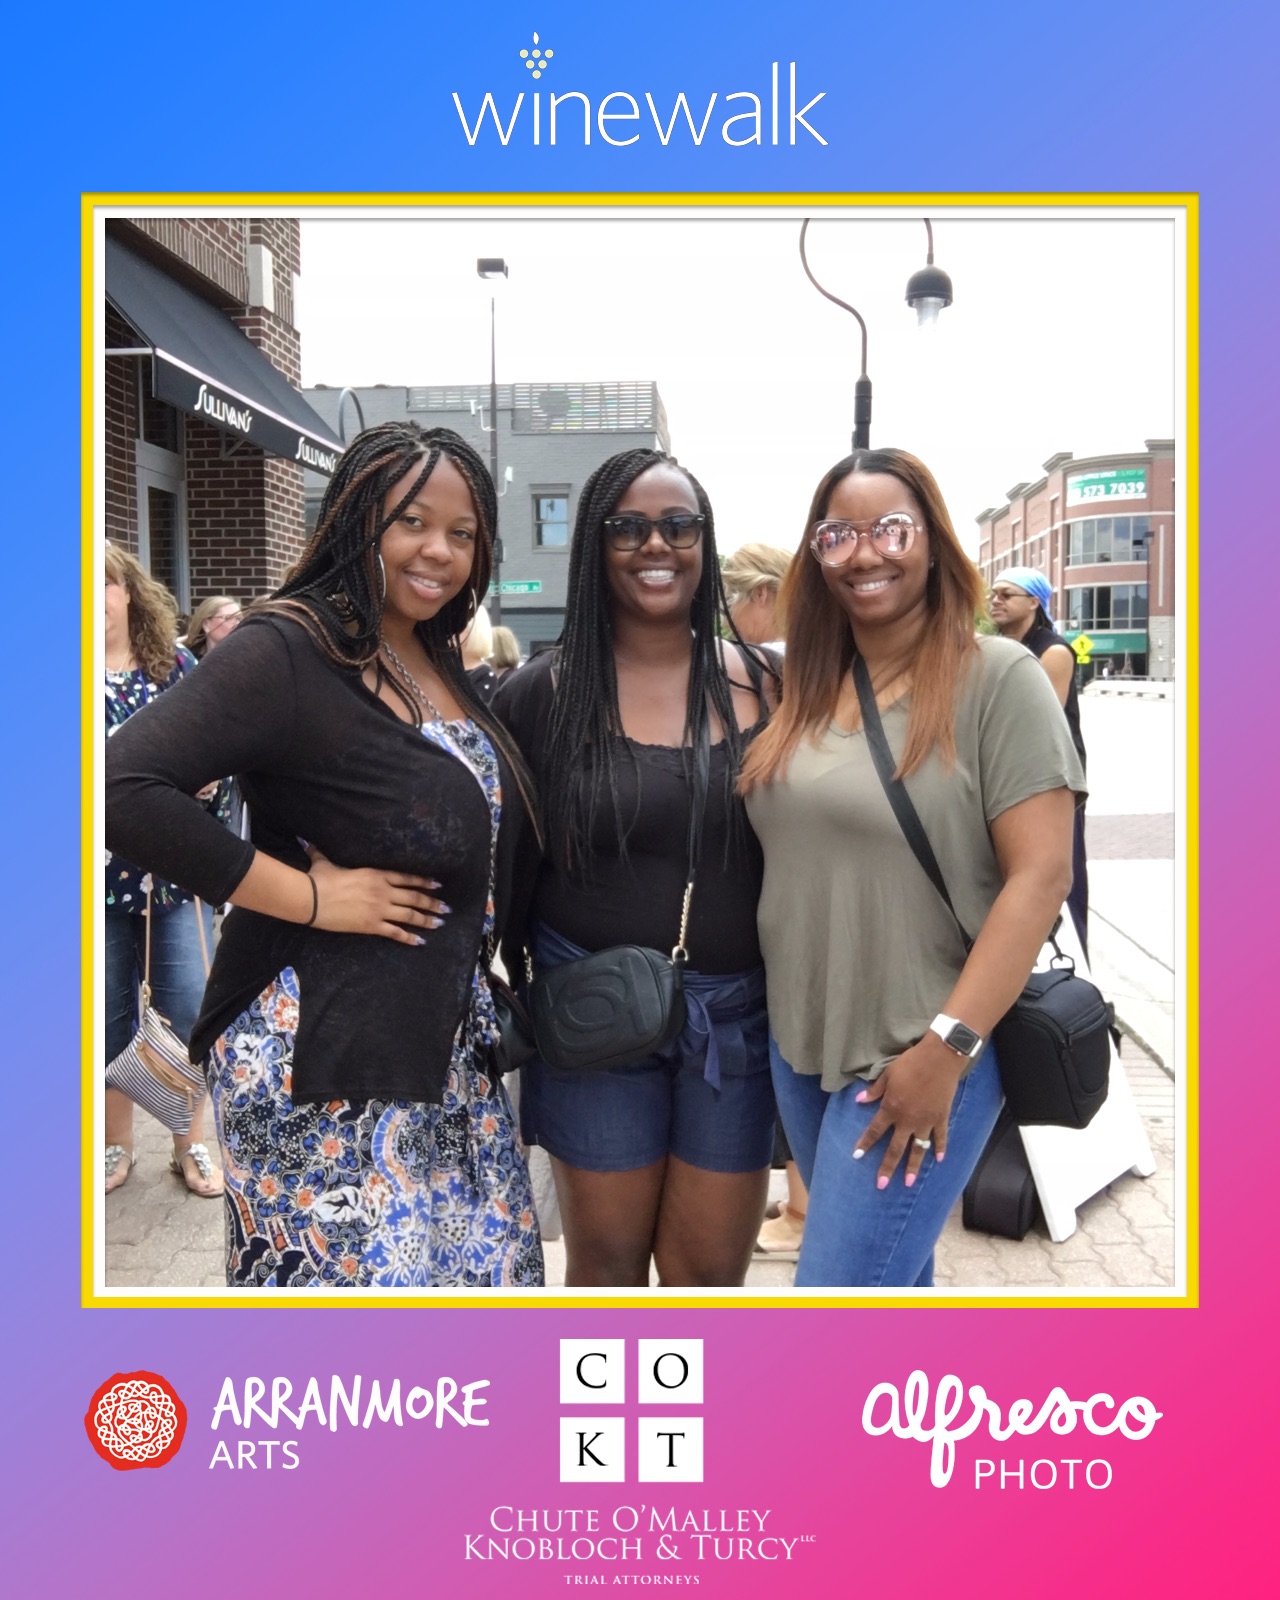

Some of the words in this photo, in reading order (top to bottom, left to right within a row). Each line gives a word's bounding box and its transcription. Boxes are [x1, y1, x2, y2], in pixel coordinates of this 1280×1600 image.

[194, 384, 253, 433] SULLIVAN'S
[295, 437, 337, 473] SULLIVAN'S
[1083, 484, 1106, 498] 573
[1110, 482, 1145, 495] 7039
